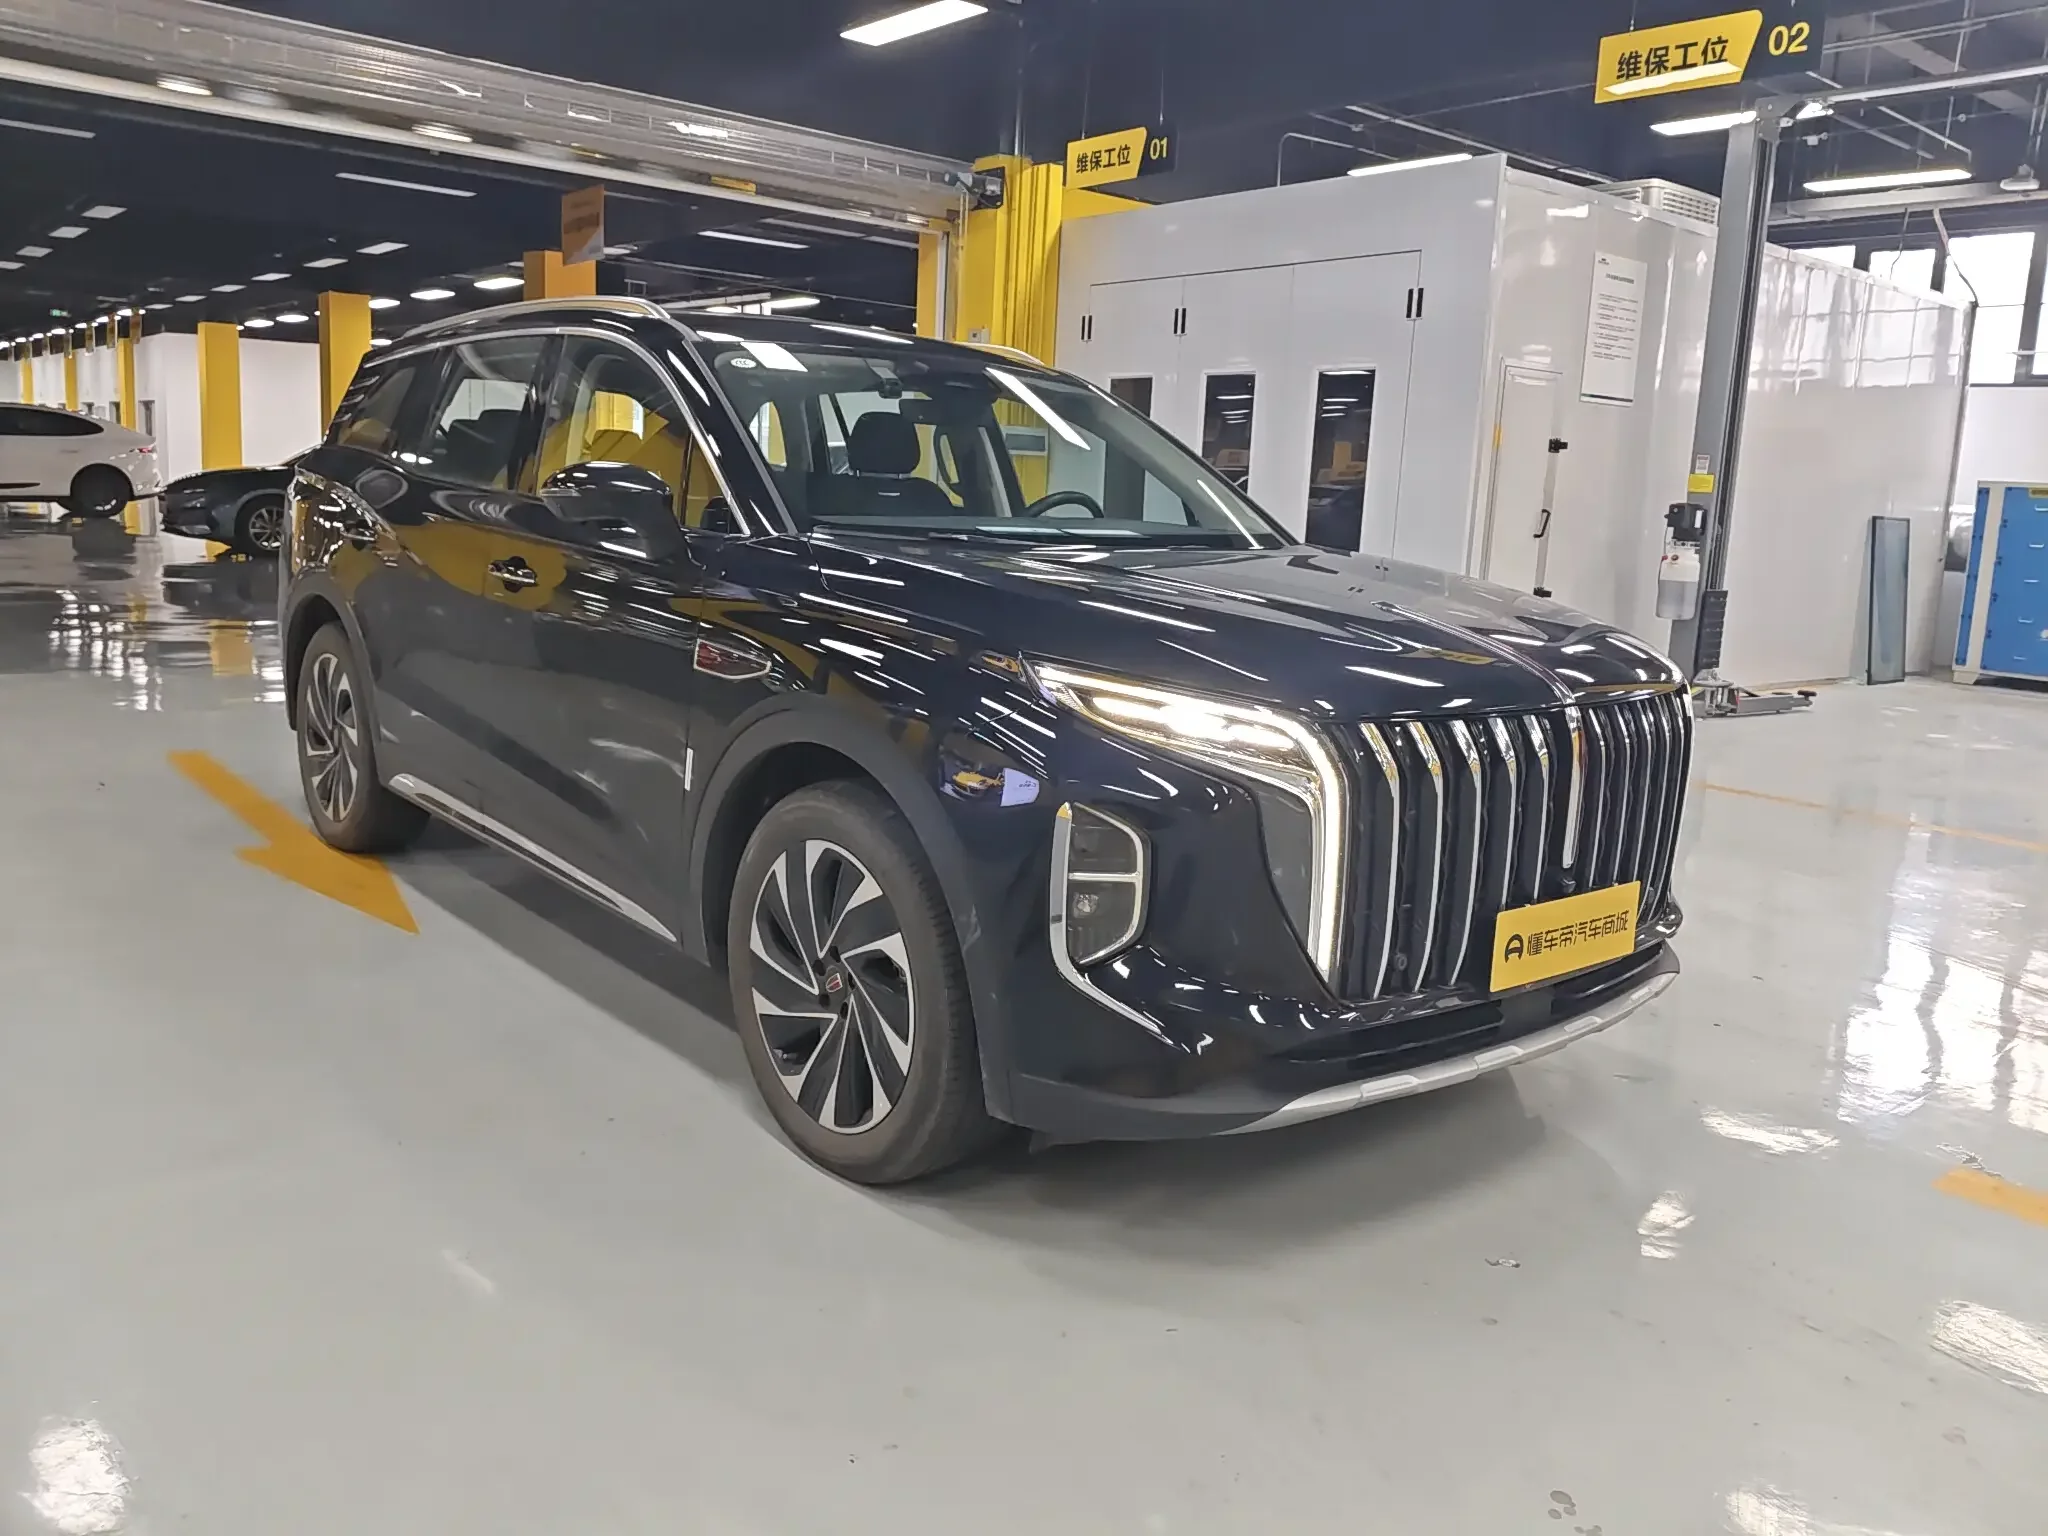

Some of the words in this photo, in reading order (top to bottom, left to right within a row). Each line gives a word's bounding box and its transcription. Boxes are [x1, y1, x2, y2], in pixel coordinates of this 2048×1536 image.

[1616, 35, 1729, 80] 维保工位
[1768, 22, 1810, 56] 02
[1076, 144, 1131, 174] 维保工位
[1150, 137, 1168, 160] 01
[1527, 909, 1630, 956] 懂车帝汽车商城
